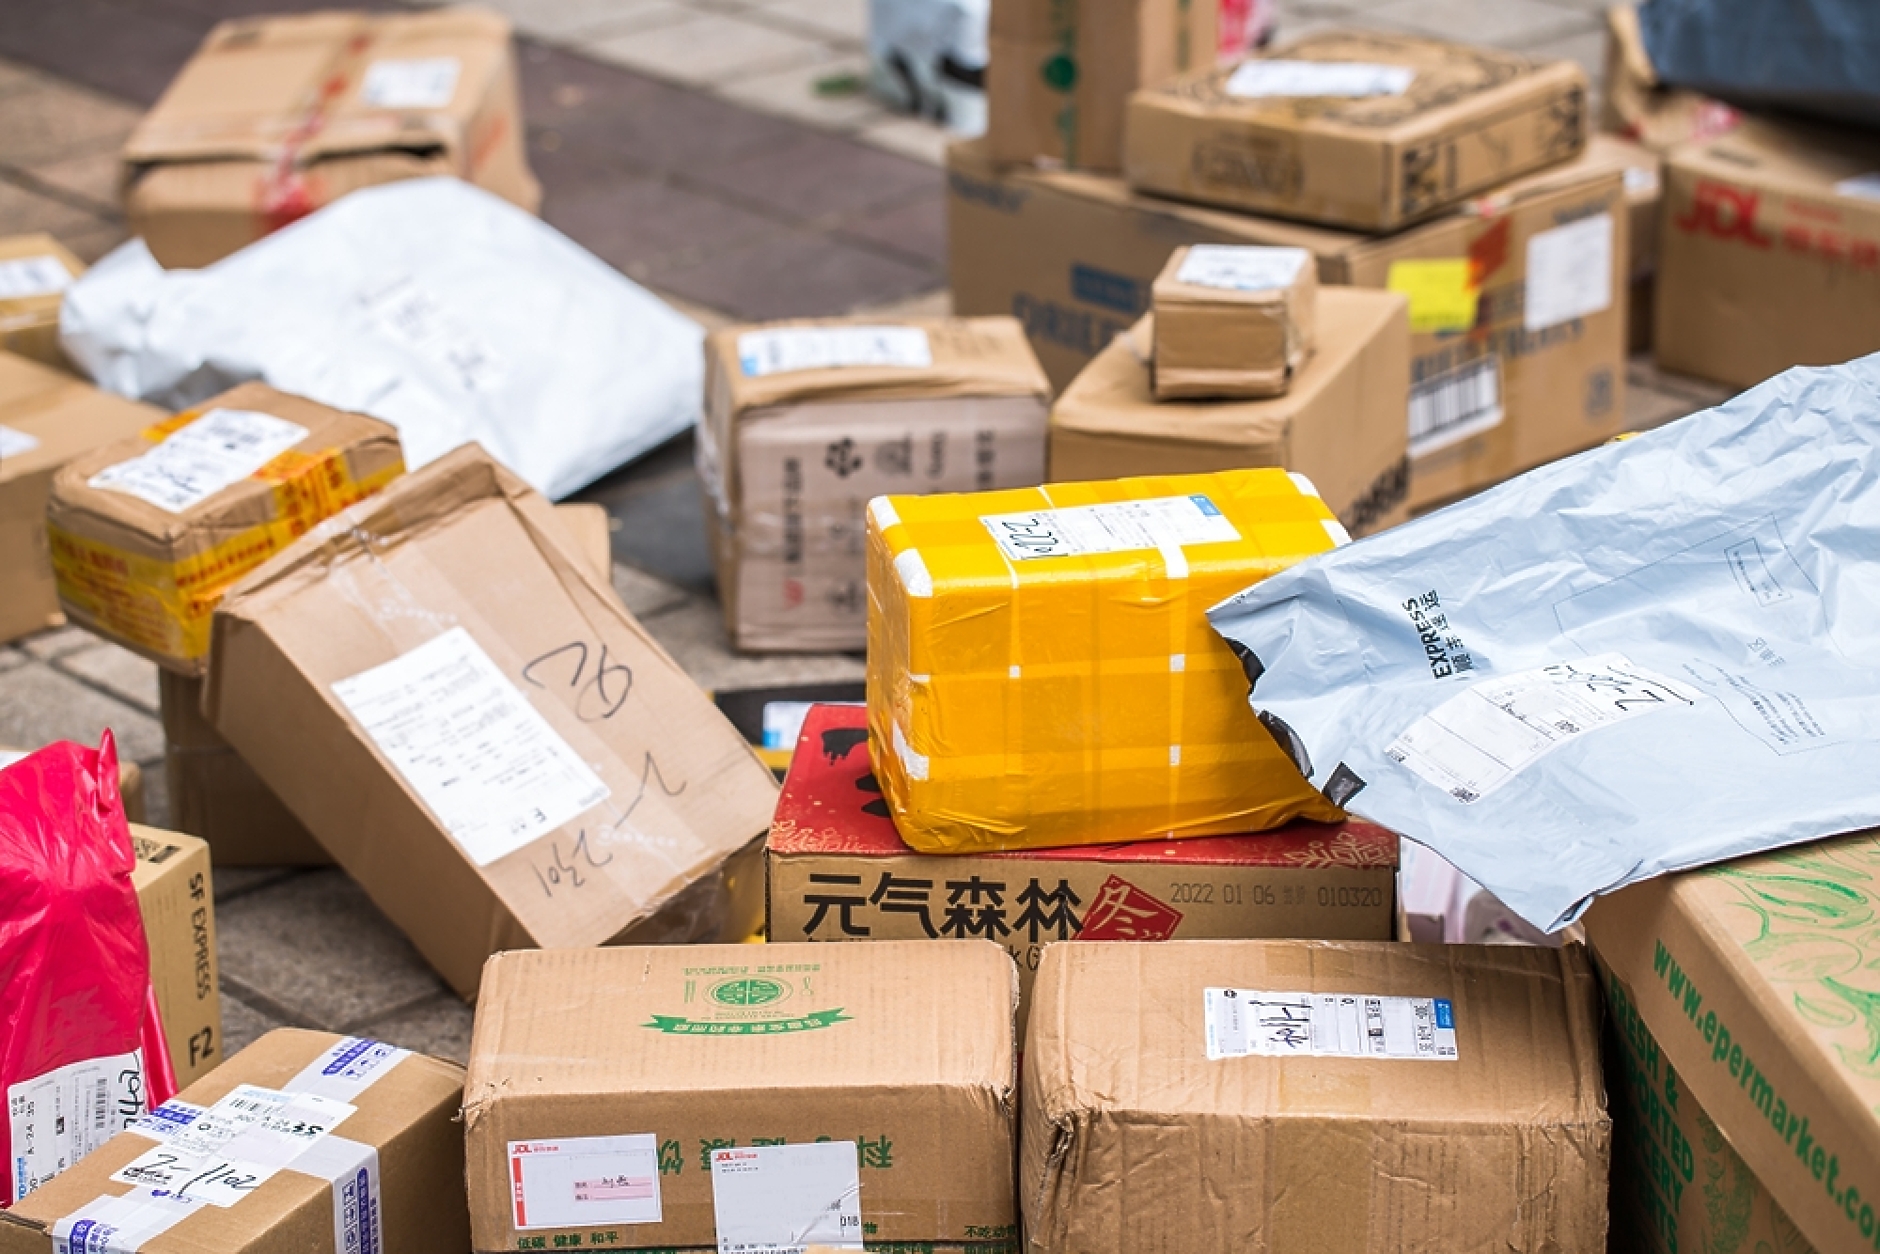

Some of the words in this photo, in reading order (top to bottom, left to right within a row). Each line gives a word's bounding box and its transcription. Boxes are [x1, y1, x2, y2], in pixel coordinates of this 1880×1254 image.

[1674, 176, 1772, 249] JDL
[1402, 597, 1453, 679] EXPRESS
[188, 871, 206, 901] SF
[803, 873, 1084, 942] 元气森林
[1170, 882, 1214, 904] 2022
[1223, 884, 1242, 905] 01
[1253, 885, 1275, 906] 06
[1317, 886, 1383, 907] 010320
[1091, 884, 1159, 936] 冬
[191, 907, 212, 1001] EXPRESS
[188, 1025, 214, 1068] F2
[1654, 938, 1880, 1252] www.epermarket.co
[513, 1145, 532, 1155] JDL
[716, 1152, 734, 1162] JDL
[517, 1236, 546, 1249] 低碳
[553, 1233, 582, 1248] 健康
[590, 1231, 619, 1245] 和平
